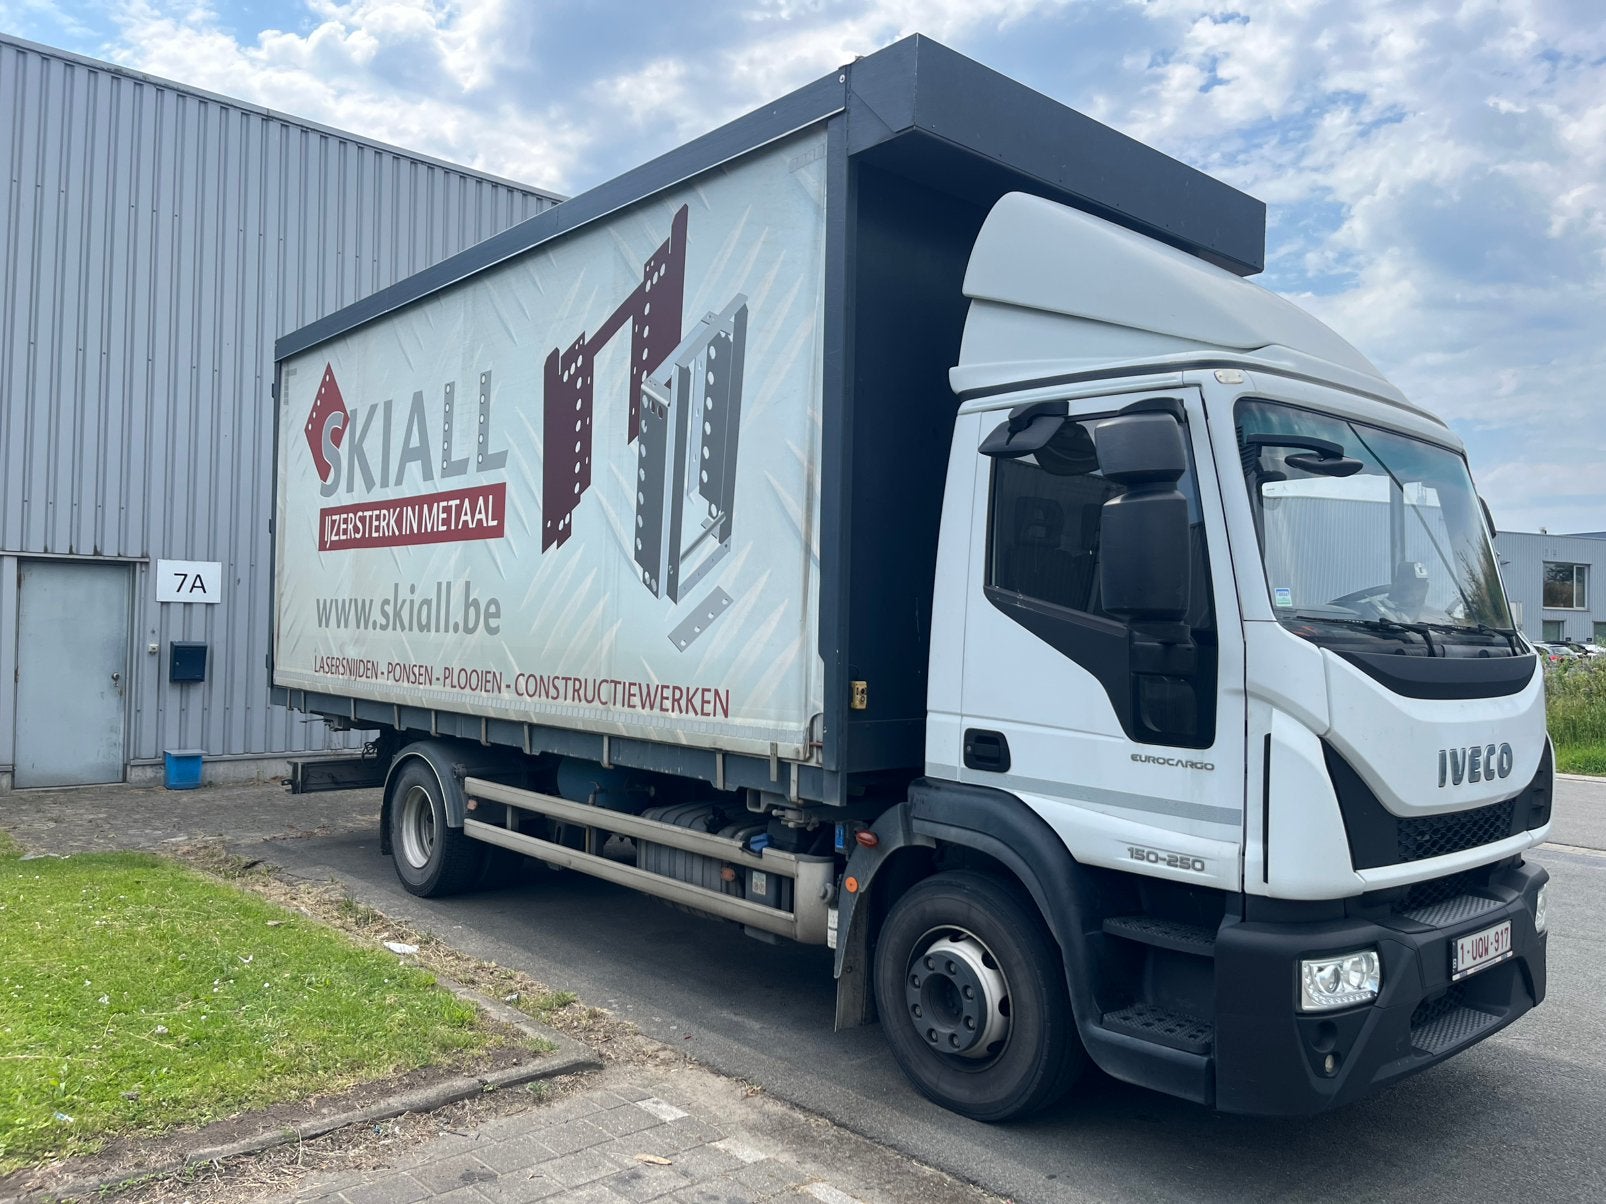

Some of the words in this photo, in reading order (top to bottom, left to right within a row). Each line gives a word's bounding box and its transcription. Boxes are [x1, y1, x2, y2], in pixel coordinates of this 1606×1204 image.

[320, 370, 508, 497] SKIALL
[324, 507, 399, 548] IJZERSTERK
[402, 505, 417, 534] IN
[421, 495, 498, 532] METAAL
[173, 573, 207, 594] 7A
[316, 581, 501, 636] www.skiall.be
[314, 655, 379, 681] LASERSNIJDEN
[386, 662, 433, 686] PONSEN
[443, 667, 502, 694] PLOOIEN
[514, 673, 730, 718] CONSTRUCTIEWERKEN
[1130, 753, 1215, 771] EUROCARGO
[1438, 742, 1514, 788] IVECO
[1127, 846, 1205, 872] 150-250
